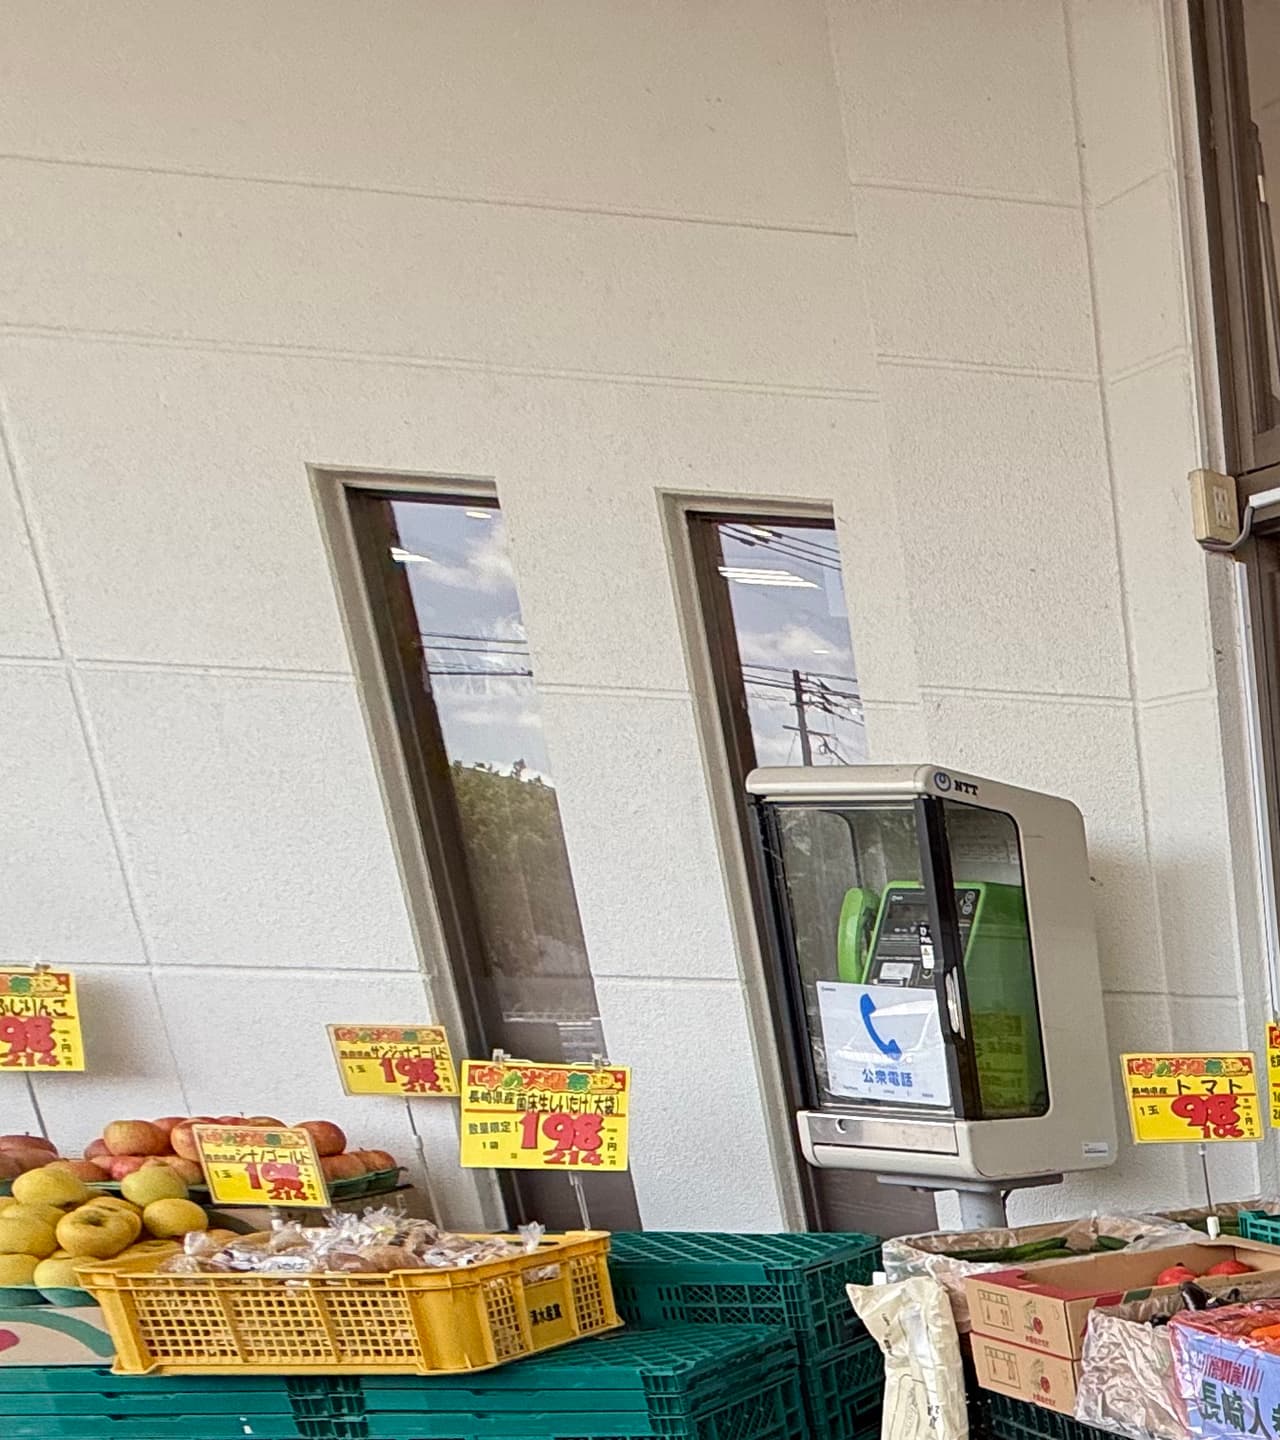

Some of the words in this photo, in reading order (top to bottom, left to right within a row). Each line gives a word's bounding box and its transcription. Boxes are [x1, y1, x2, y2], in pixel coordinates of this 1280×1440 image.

[954, 779, 978, 796] NTT
[378, 1057, 440, 1083] 198
[862, 1068, 913, 1088] 公衆電話
[1176, 1079, 1243, 1096] トマト
[468, 1090, 516, 1105] 長崎県産
[1170, 1094, 1242, 1127] 98
[518, 1111, 606, 1150] 198
[542, 1149, 604, 1166] 214
